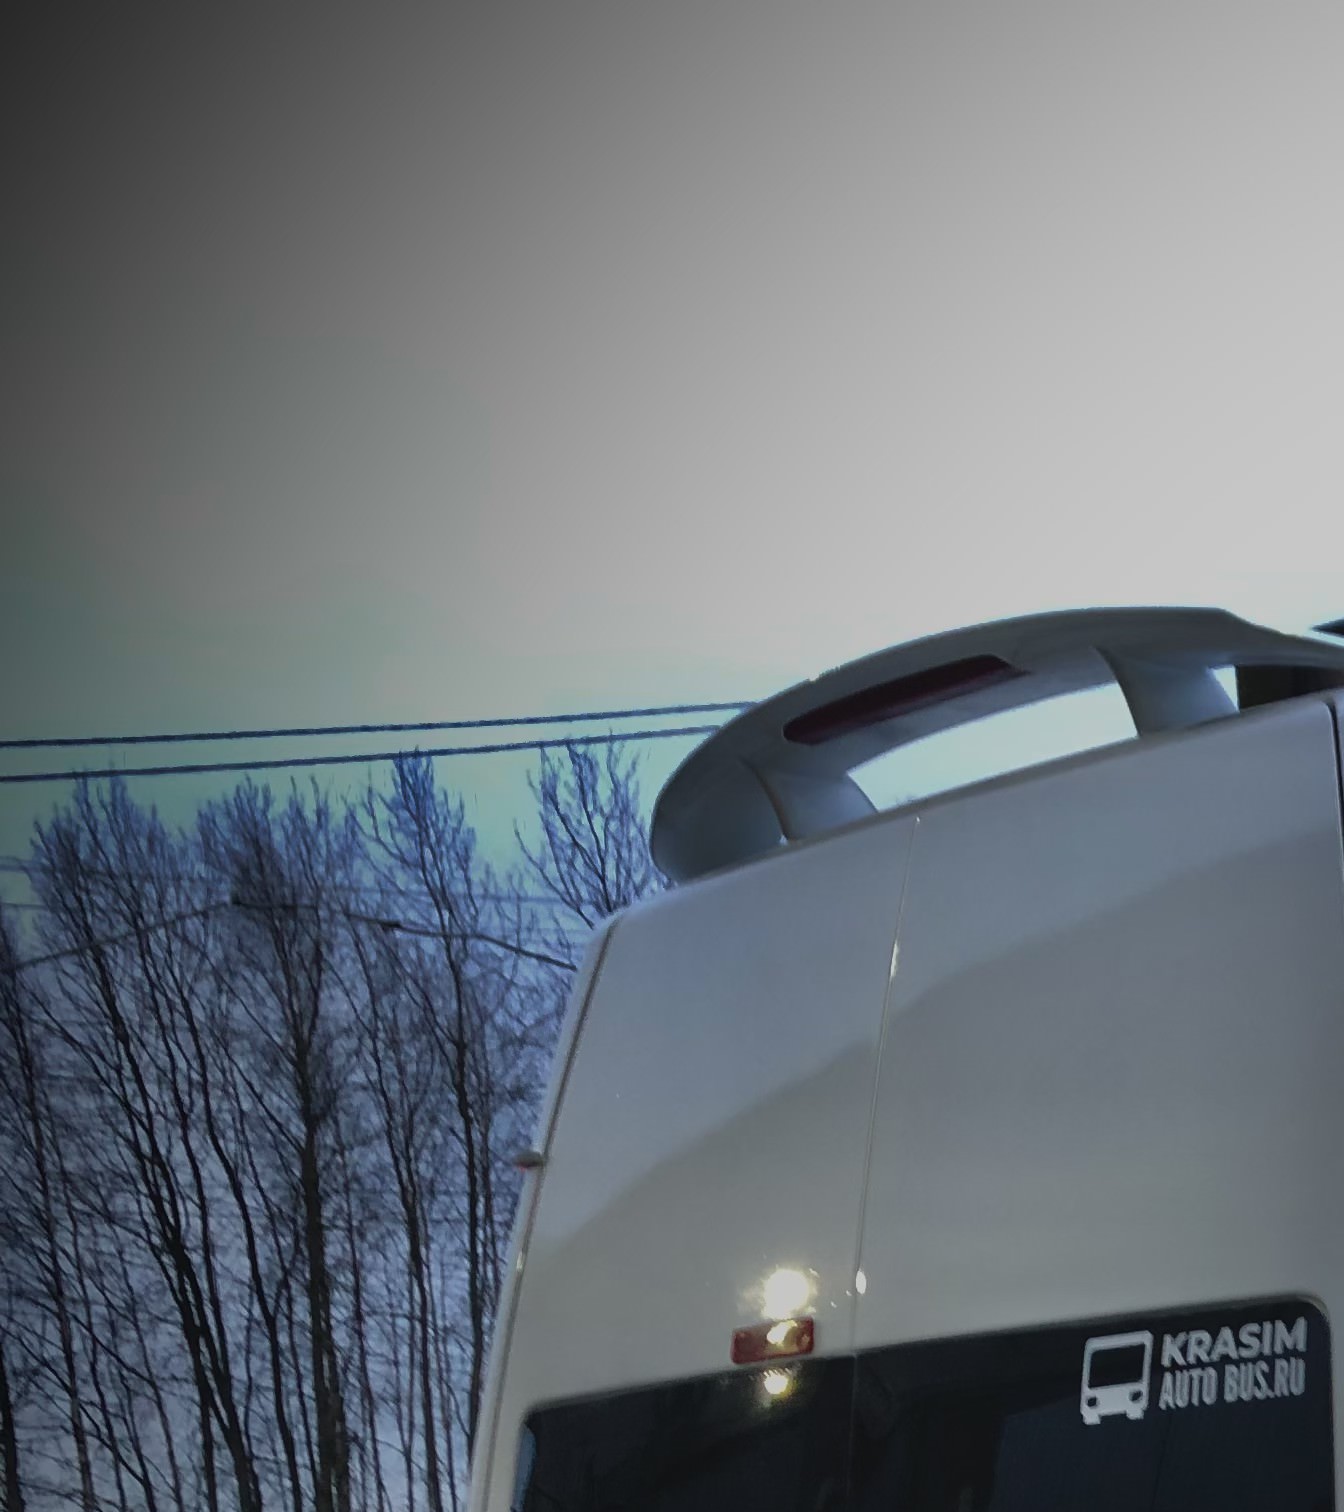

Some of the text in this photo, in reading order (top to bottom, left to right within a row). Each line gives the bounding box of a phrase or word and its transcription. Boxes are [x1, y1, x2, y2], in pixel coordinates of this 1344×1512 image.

[1161, 1318, 1307, 1367] KRASIM
[1159, 1358, 1306, 1410] AUTO BUS.RU
